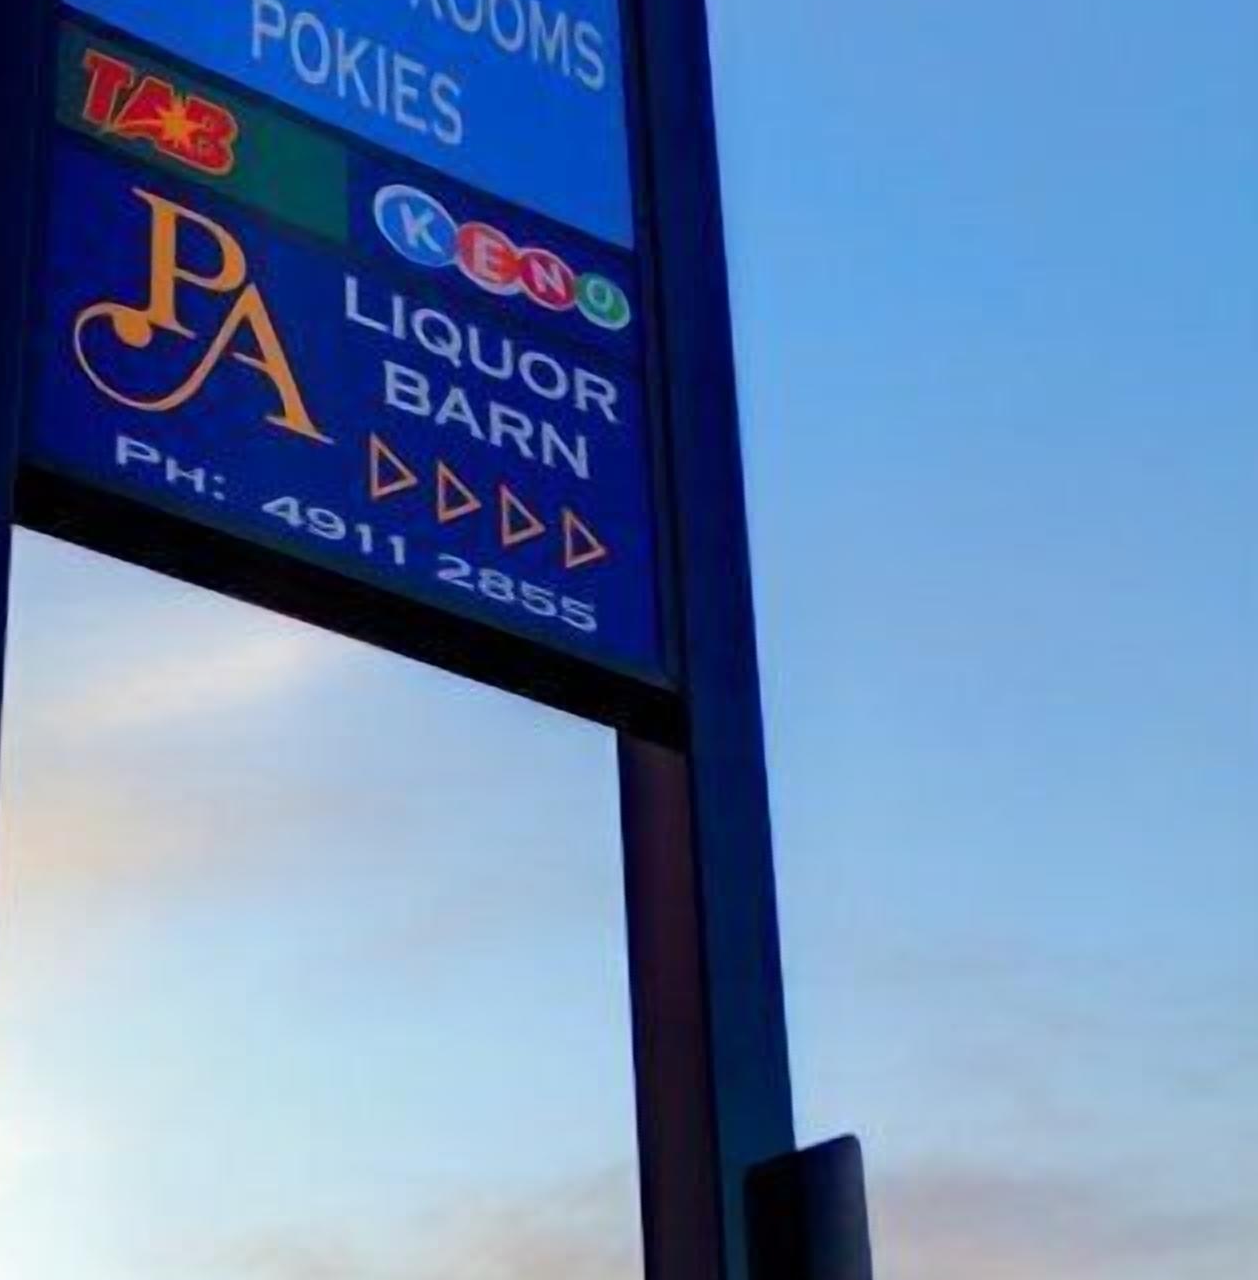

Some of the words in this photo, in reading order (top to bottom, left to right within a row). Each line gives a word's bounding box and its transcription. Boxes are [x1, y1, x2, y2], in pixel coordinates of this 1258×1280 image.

[83, 48, 239, 176] TAB
[387, 193, 624, 320] KENO
[343, 275, 619, 423] LIQUOR
[383, 360, 591, 480] BARN
[115, 434, 228, 502] PH:
[260, 494, 407, 567] 4911
[437, 552, 599, 634] 2855
